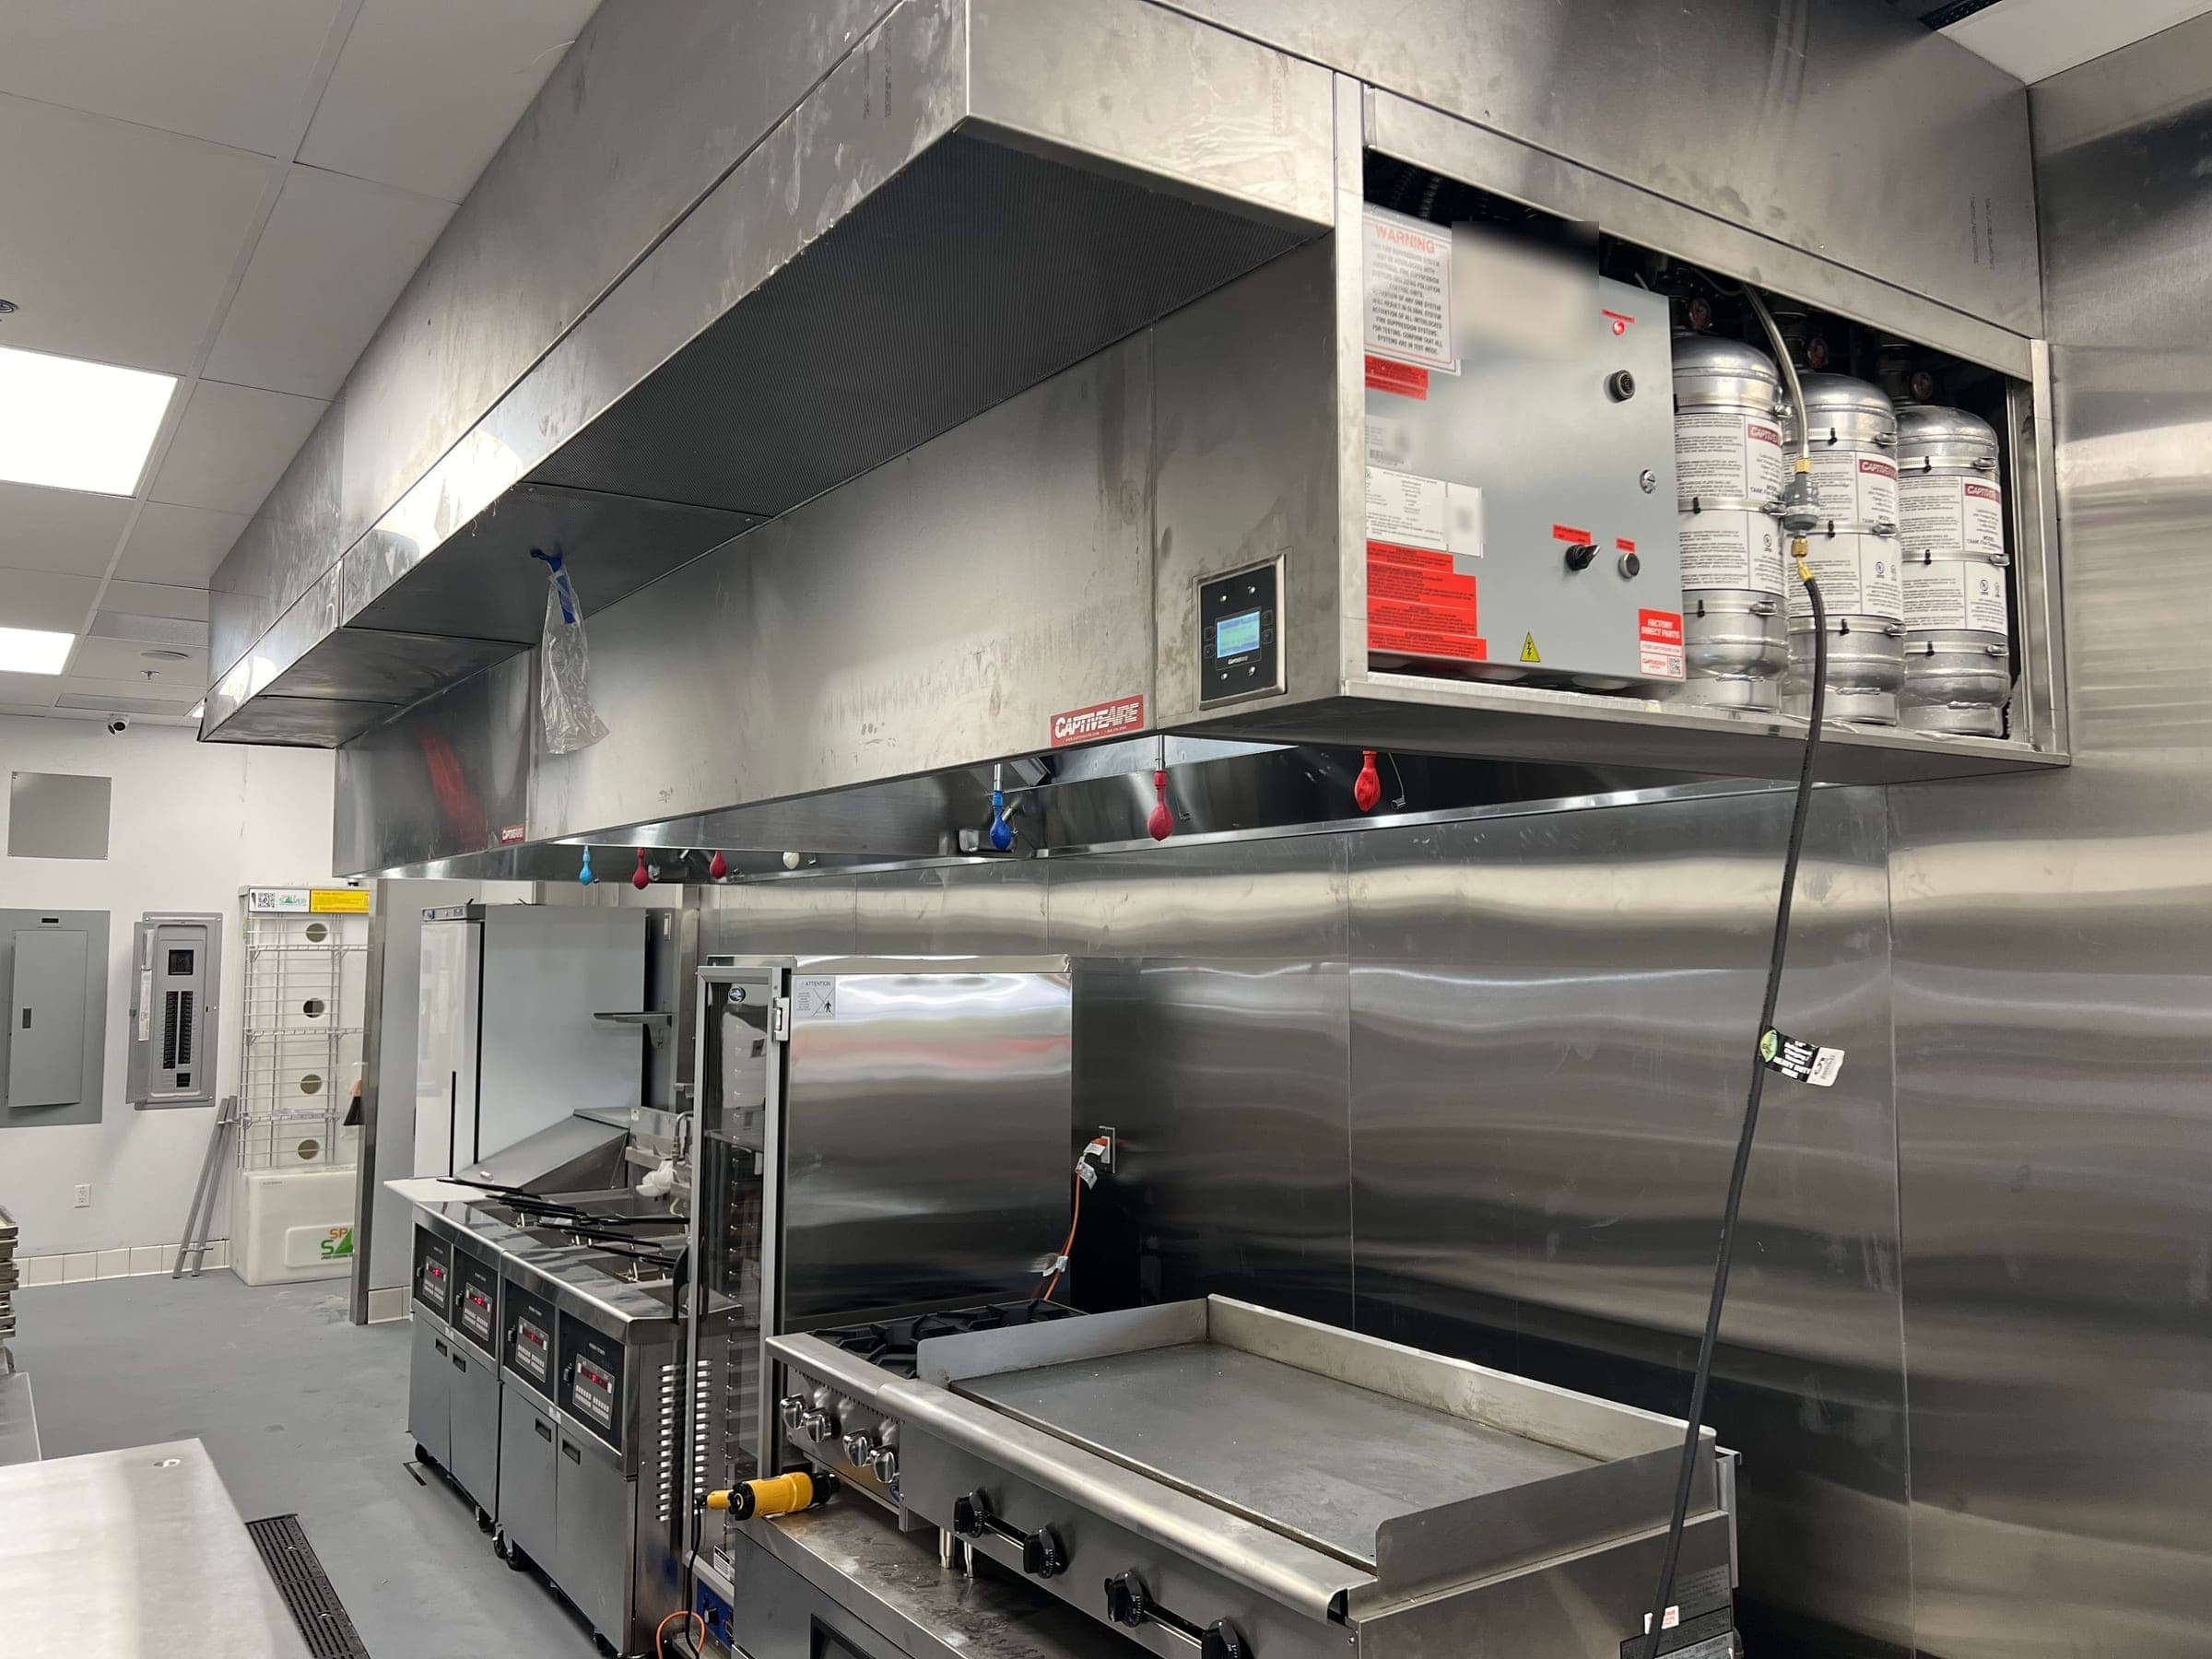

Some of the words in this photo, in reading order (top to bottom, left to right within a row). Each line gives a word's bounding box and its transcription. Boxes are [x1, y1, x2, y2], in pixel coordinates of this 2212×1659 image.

[1376, 224, 1435, 253] WARNING
[1641, 626, 1661, 637] DIRECT
[1662, 629, 1681, 640] PARTS
[1647, 618, 1674, 629] FACTORY
[1054, 702, 1139, 738] CAPTIVEAIRE
